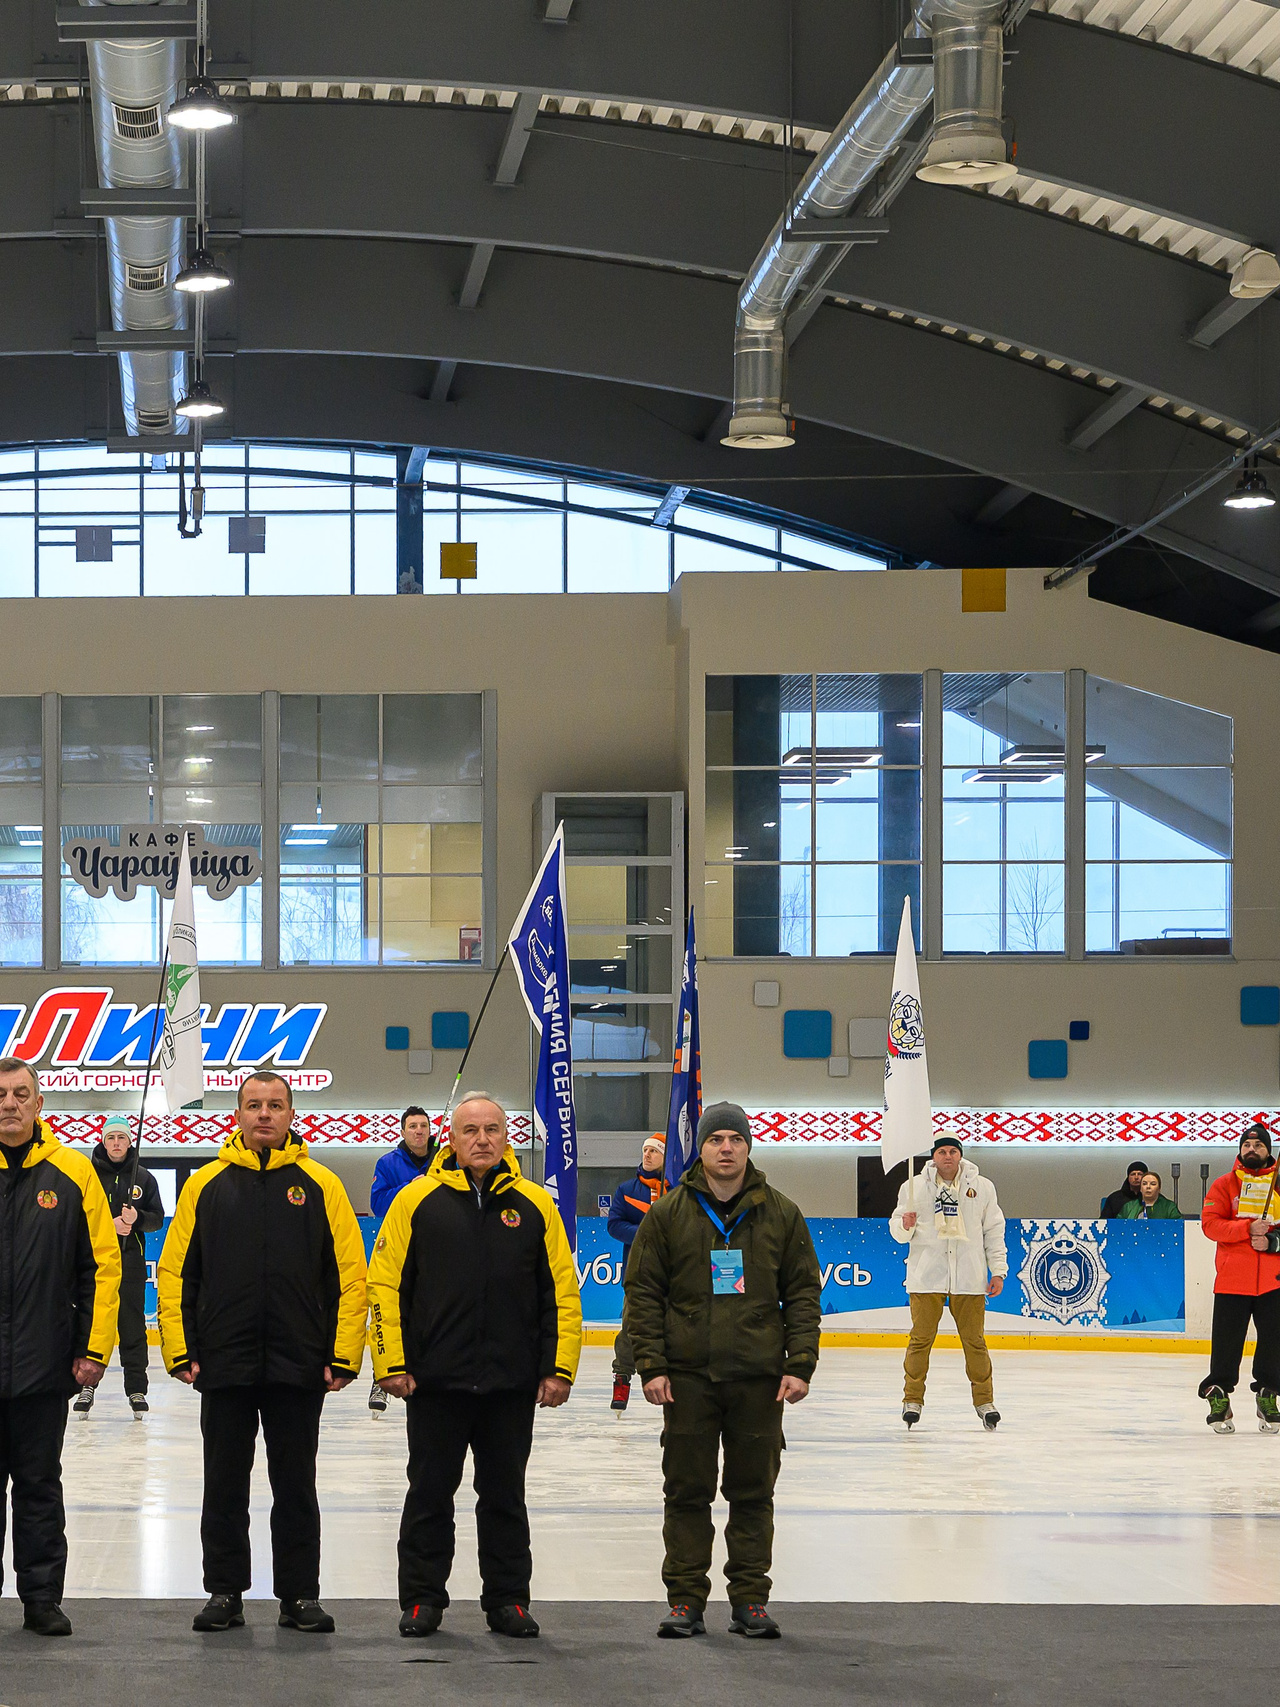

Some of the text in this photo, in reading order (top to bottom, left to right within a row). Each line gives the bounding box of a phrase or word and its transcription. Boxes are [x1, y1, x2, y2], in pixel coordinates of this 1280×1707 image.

[129, 832, 196, 847] КАФЕ
[84, 1071, 249, 1087] ГОРНОЛНЫ
[551, 1060, 575, 1171] СЕРВИСА
